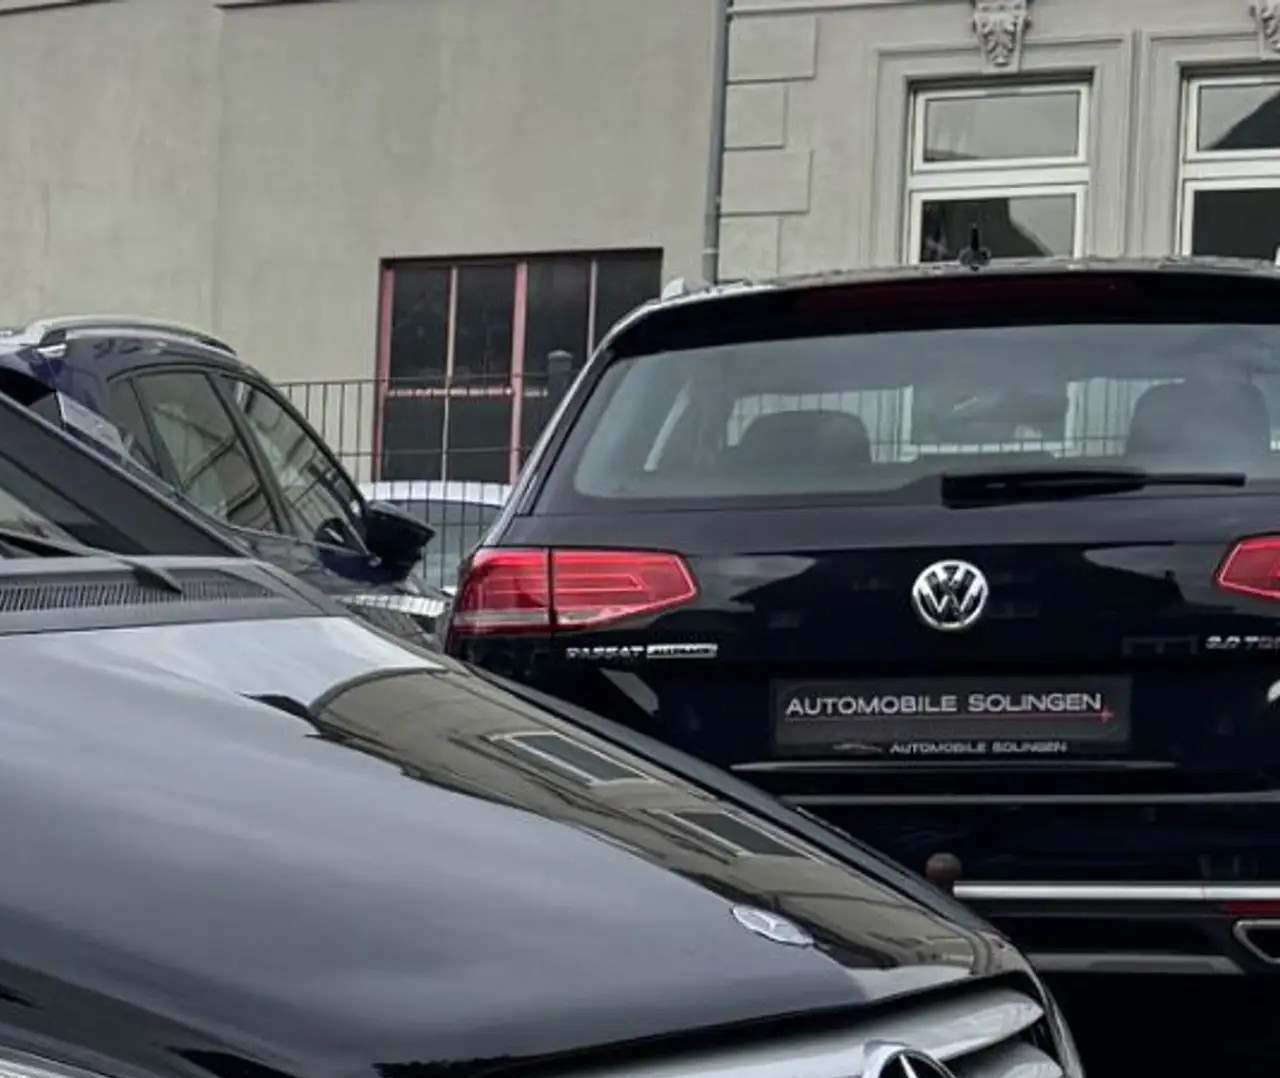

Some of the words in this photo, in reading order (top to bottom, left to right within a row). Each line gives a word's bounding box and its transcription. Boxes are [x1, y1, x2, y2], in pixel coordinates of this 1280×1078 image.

[784, 694, 958, 716] AUTOMOBILE
[967, 692, 1102, 713] SOLINGEN
[889, 741, 987, 755] AUTOMOBILE
[991, 740, 1068, 754] SOLINGEN
